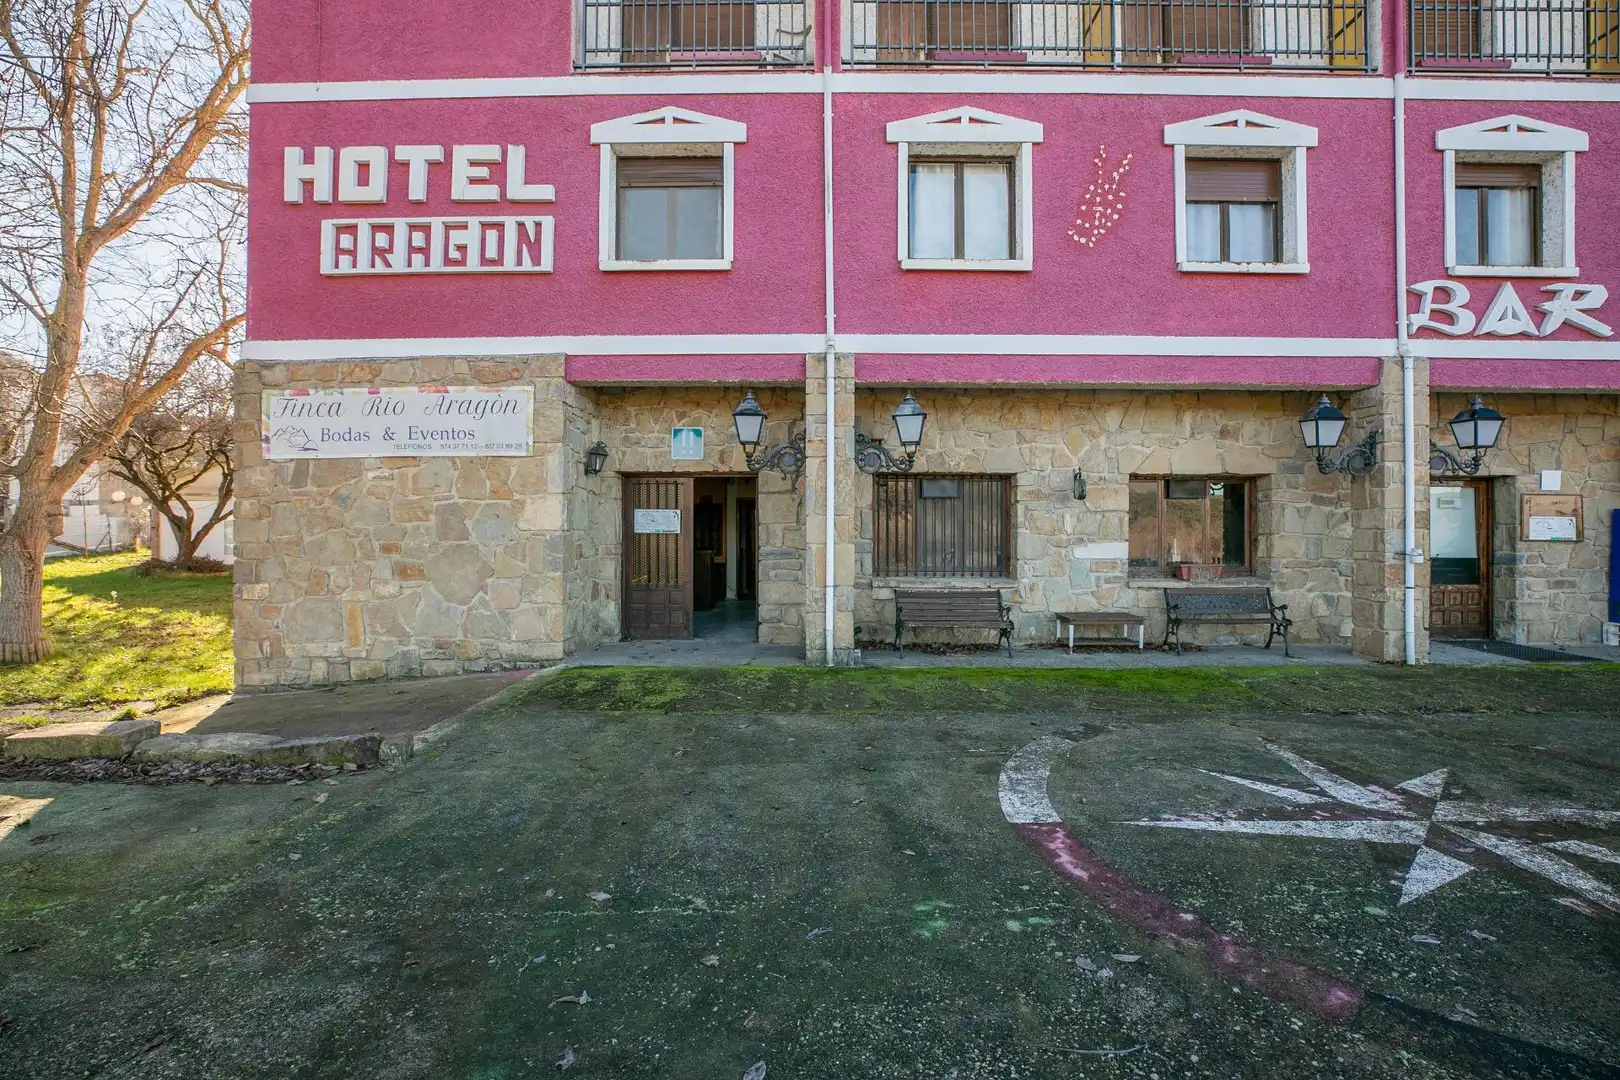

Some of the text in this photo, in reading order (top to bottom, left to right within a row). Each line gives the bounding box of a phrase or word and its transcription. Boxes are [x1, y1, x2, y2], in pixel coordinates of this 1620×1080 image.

[284, 145, 555, 204] HOTEL
[324, 218, 553, 274] ARAGON
[1406, 280, 1614, 338] BAR
[273, 397, 347, 418] Finca
[320, 426, 475, 442] Bodas & Eventos
